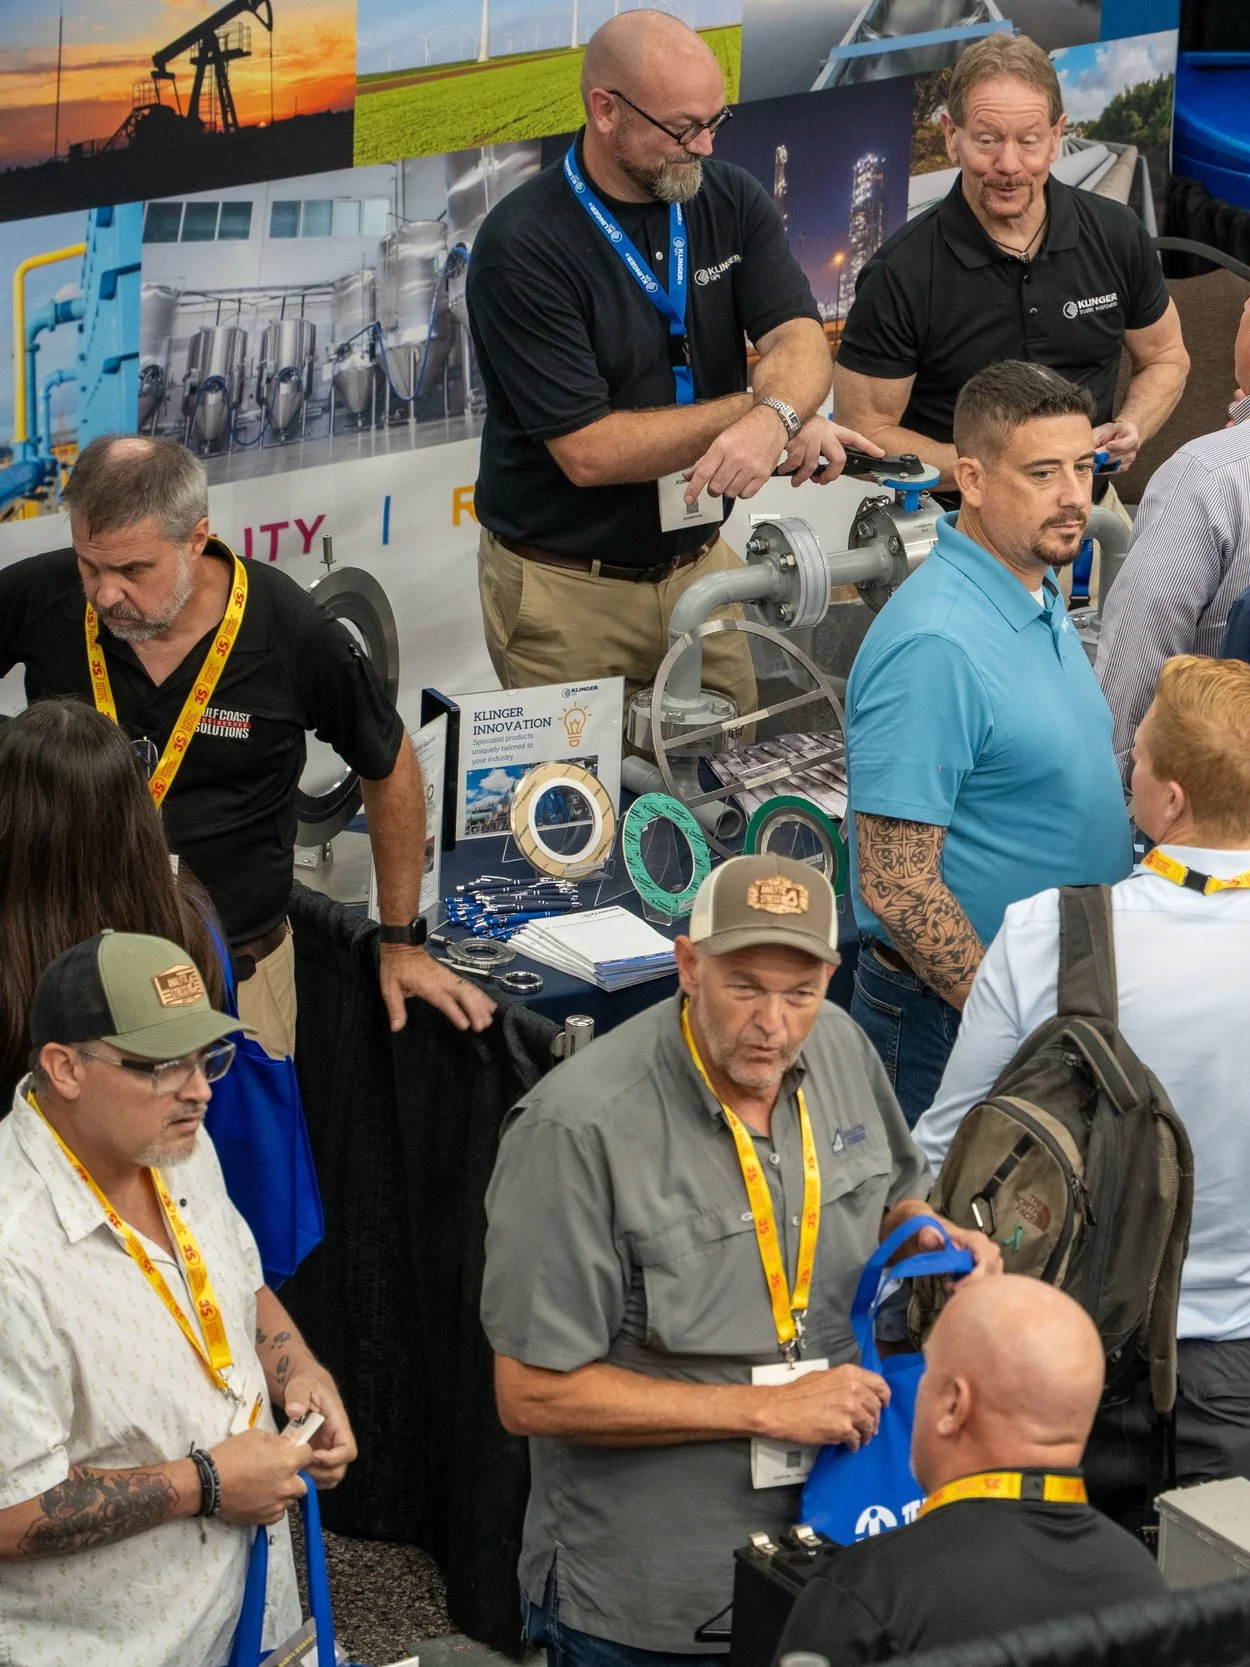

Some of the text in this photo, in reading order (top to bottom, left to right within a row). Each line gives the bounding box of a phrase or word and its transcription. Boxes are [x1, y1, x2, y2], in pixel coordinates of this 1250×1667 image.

[708, 255, 741, 274] KLINGER
[1077, 293, 1118, 308] KLINGER
[243, 514, 326, 561] ITY
[216, 640, 230, 657] 3S
[92, 660, 103, 676] 3S
[195, 687, 210, 706] 3S
[203, 707, 252, 723] ULF COAST
[474, 707, 524, 722] KLINGER
[195, 722, 250, 739] SOLUTIONS
[473, 717, 552, 735] INNOVATION
[173, 735, 188, 753] 3S
[472, 733, 534, 746] Specialist products
[472, 746, 500, 756] uniquely
[501, 743, 525, 752] tailored
[472, 755, 513, 766] your industry
[151, 782, 166, 799] 3S
[183, 1244, 196, 1261] 3S
[199, 1299, 213, 1318] 3S
